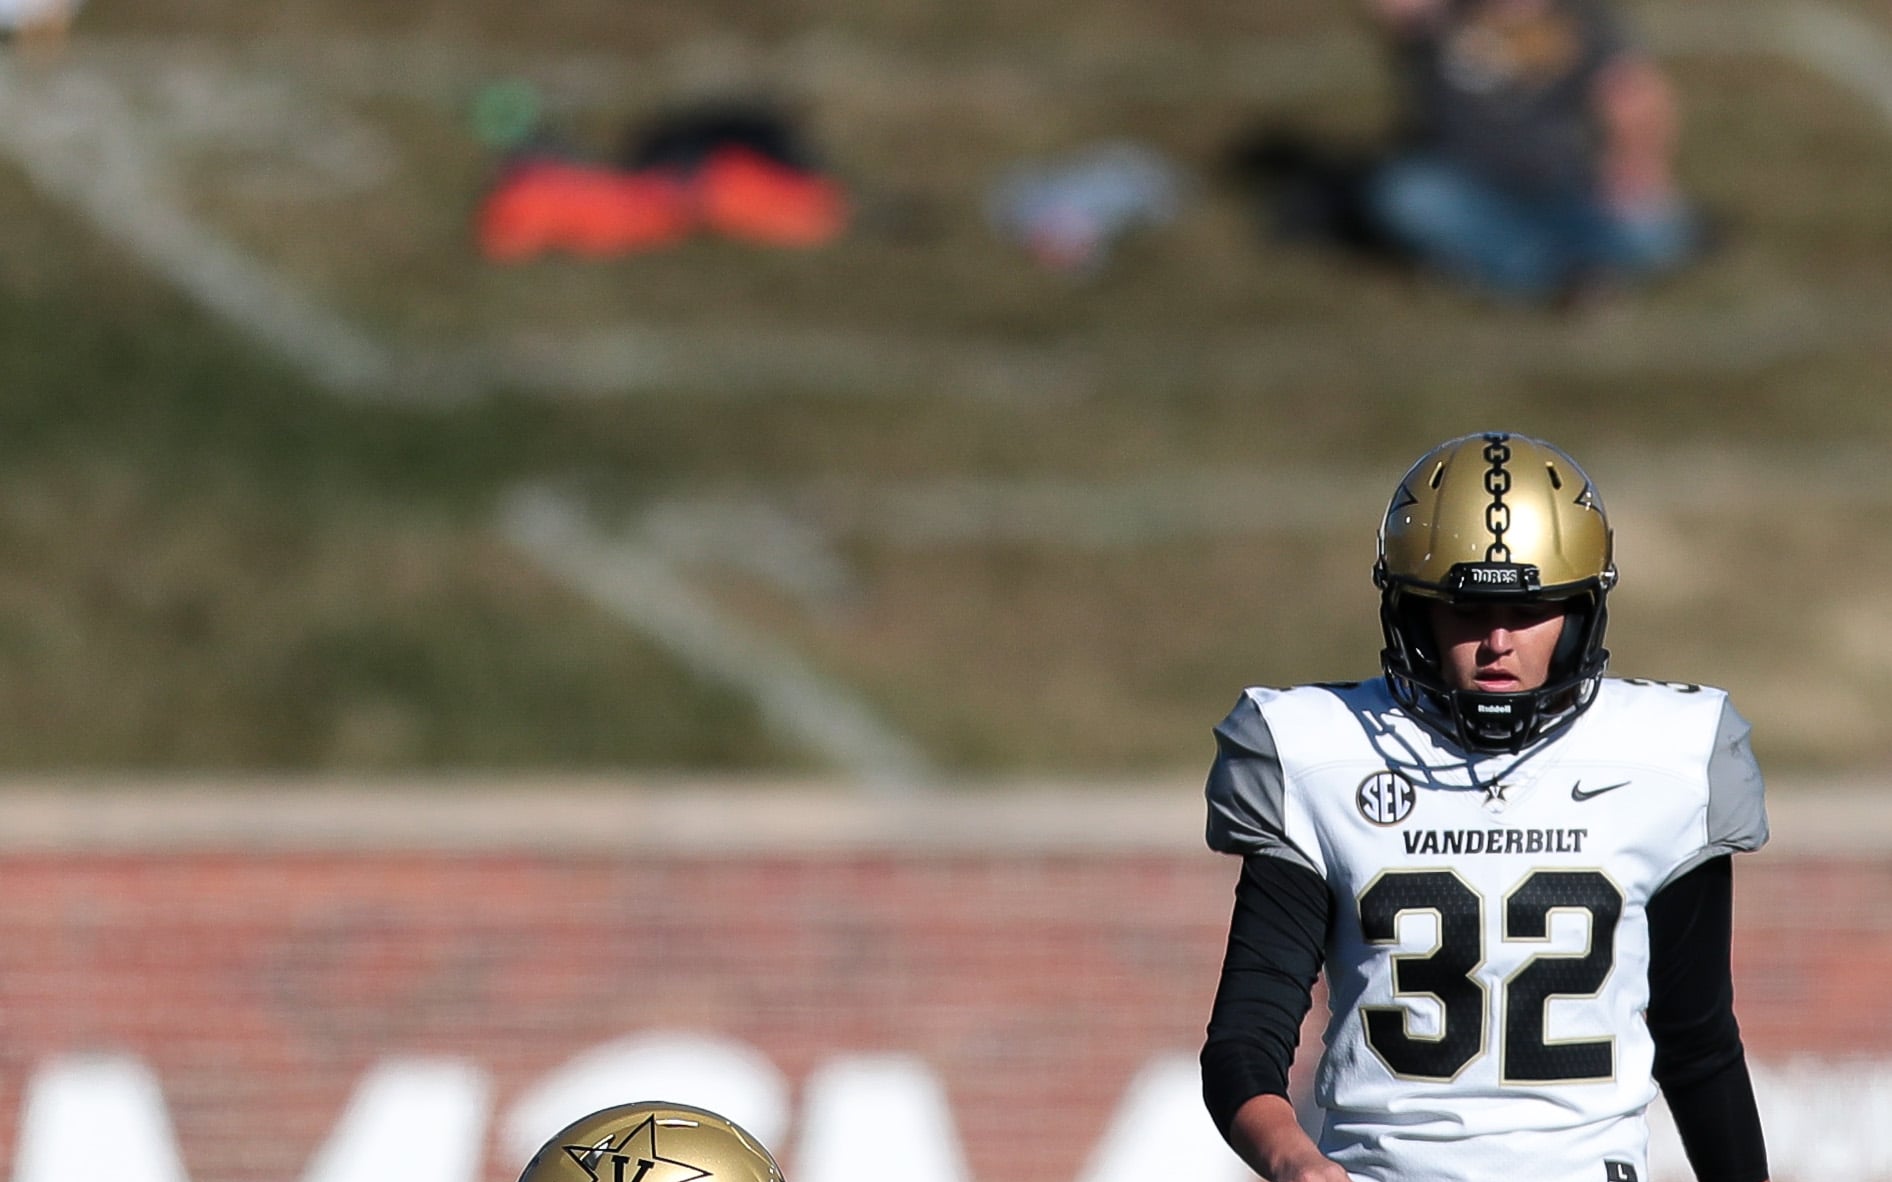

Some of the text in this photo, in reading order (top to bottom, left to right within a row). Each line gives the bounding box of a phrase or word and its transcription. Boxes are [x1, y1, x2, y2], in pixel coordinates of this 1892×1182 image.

[1359, 771, 1412, 823] SEC
[1402, 828, 1588, 855] VANDERBILT
[1356, 867, 1626, 1085] 32
[1617, 1163, 1628, 1180] L
